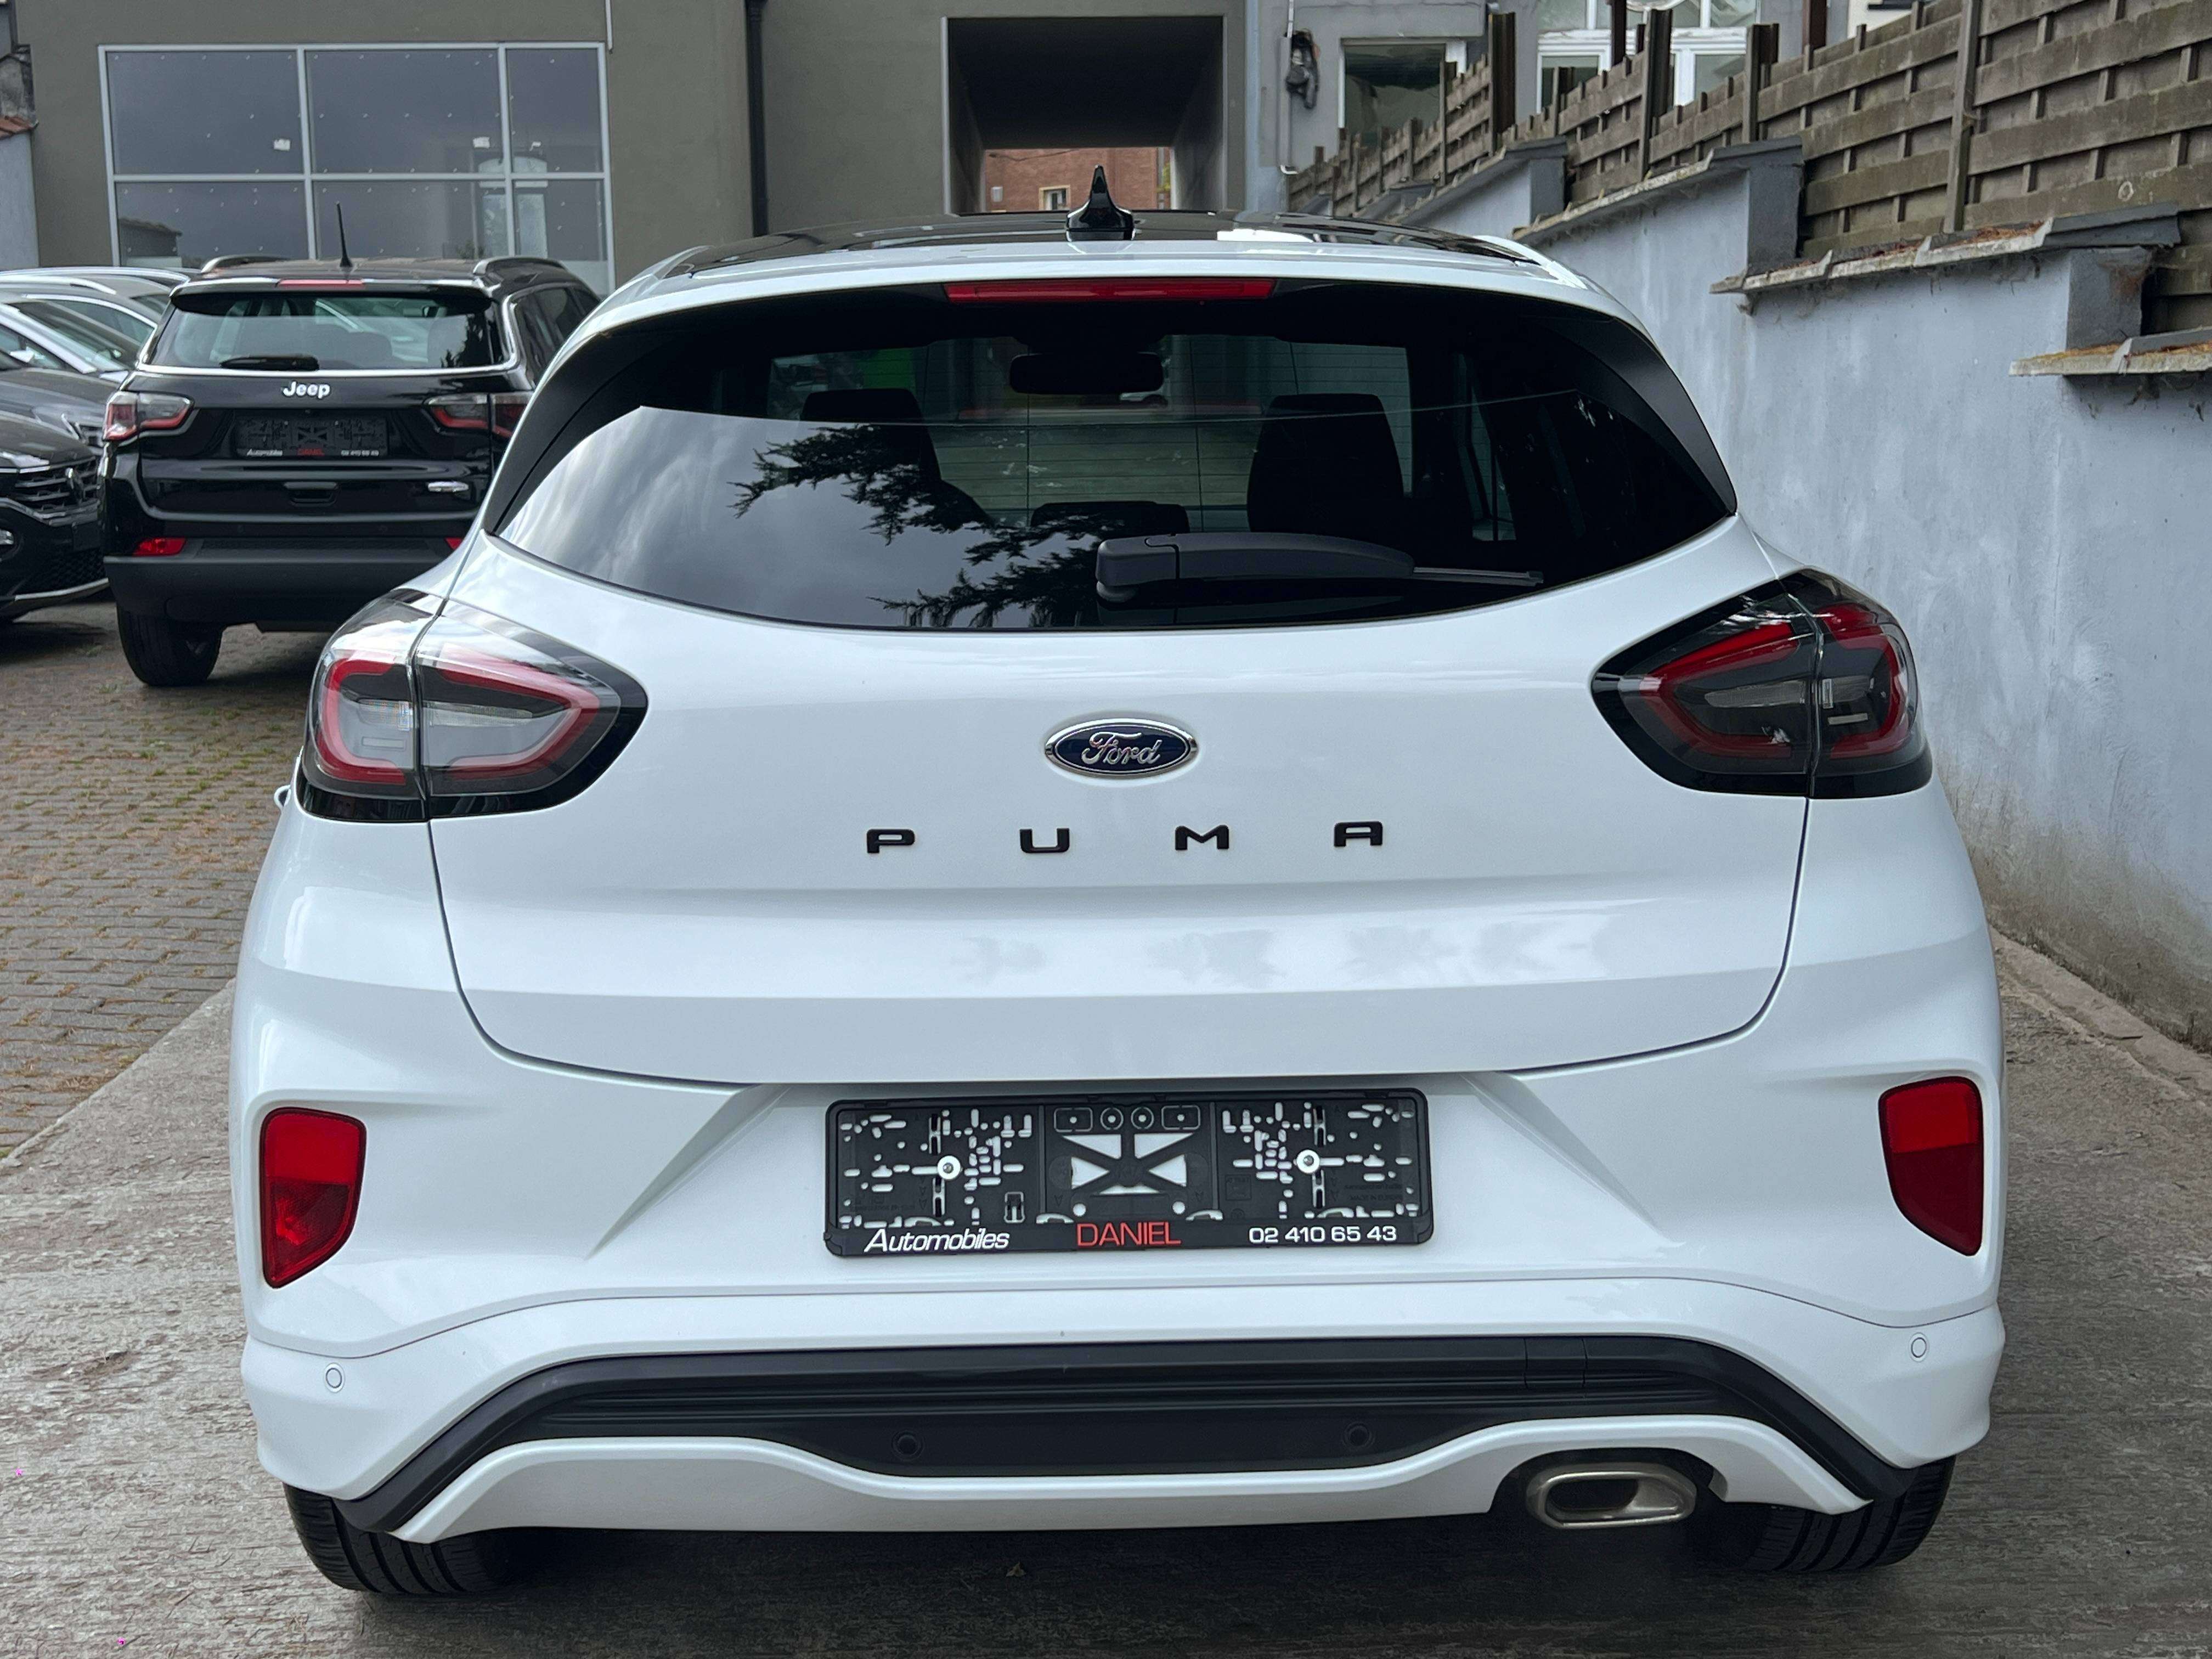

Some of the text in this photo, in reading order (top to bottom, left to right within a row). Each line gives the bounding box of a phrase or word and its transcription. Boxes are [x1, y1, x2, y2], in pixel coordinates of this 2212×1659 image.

[283, 381, 330, 399] Jeep
[1081, 731, 1163, 765] Ford
[866, 821, 1383, 854] PUMA
[864, 1221, 1397, 1252] Automobiles DANIEL 02 410 65 43
